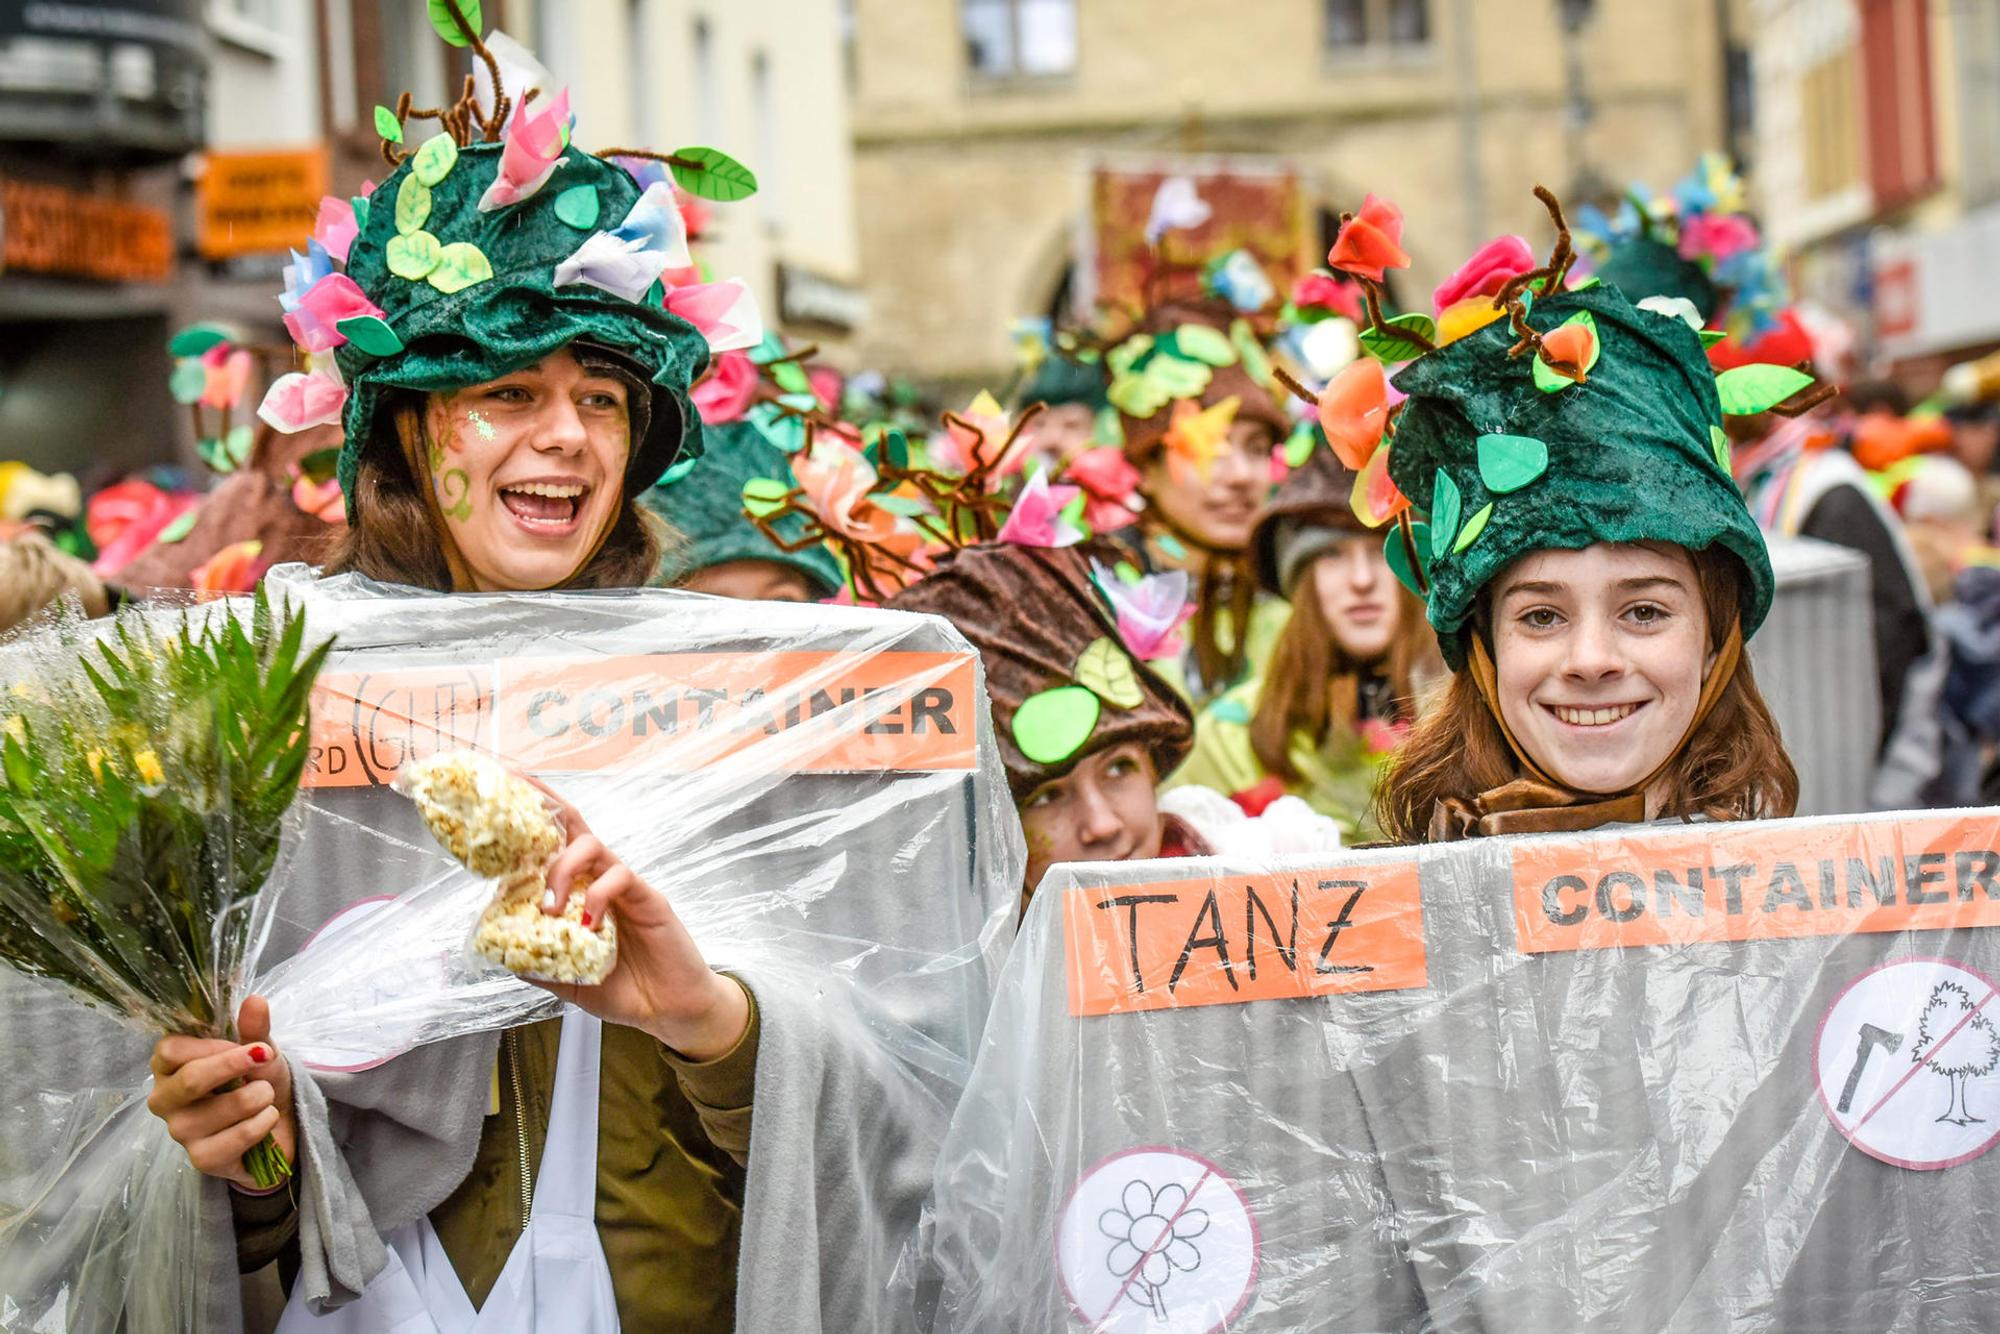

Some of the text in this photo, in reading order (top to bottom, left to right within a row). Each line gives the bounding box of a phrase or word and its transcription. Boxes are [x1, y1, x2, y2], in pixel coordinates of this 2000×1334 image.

[527, 686, 957, 737] CONTAINER
[1542, 850, 2000, 926] CONTAINER
[1096, 878, 1375, 994] TANZ
